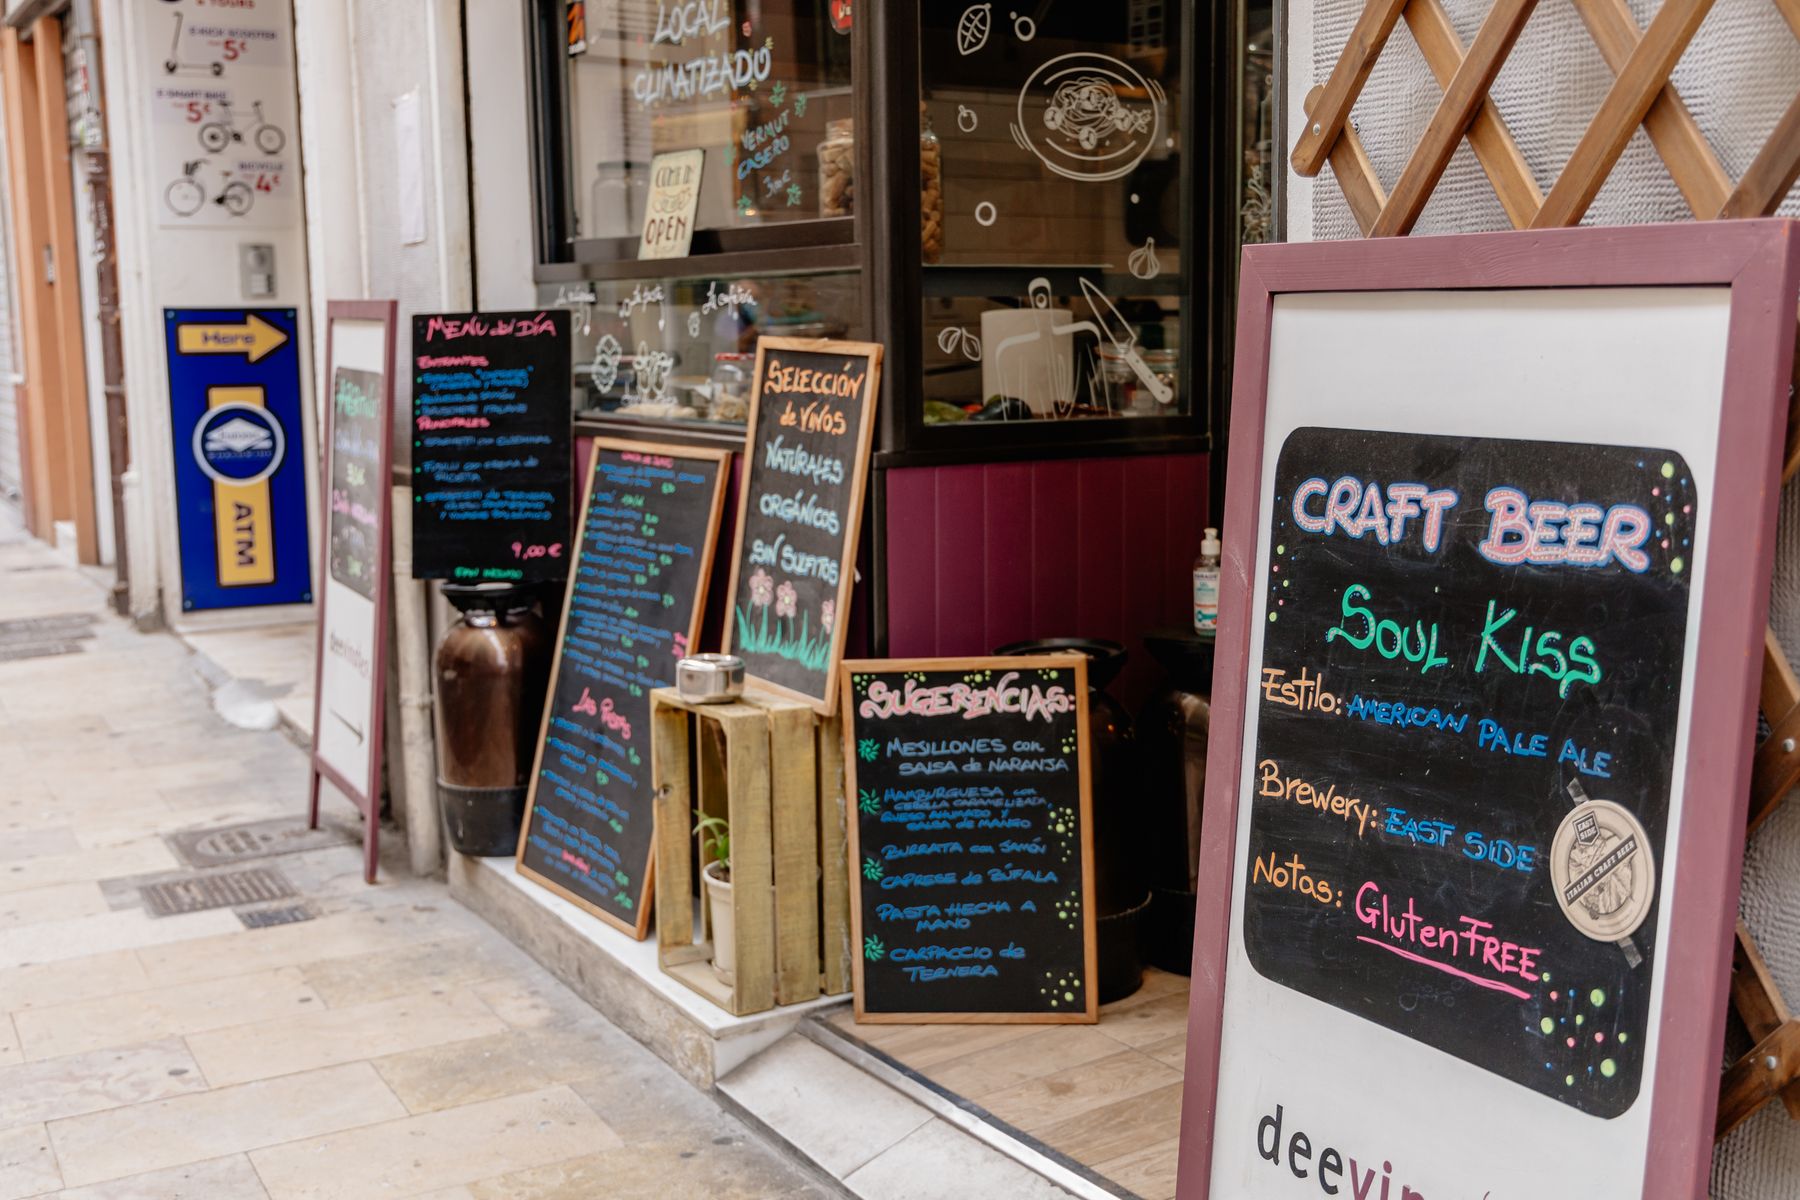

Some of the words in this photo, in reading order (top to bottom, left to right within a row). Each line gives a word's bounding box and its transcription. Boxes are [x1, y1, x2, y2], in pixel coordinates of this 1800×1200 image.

[652, 0, 731, 46] LOCAL
[632, 46, 772, 104] CLIMATIZADO
[741, 109, 790, 151] VERMUT
[645, 216, 689, 246] OPEN
[202, 331, 256, 345] Here
[763, 360, 865, 400] SELECCIÓN
[780, 401, 797, 426] de
[765, 434, 844, 485] NATURALES
[234, 502, 256, 566] ATM
[1292, 476, 1458, 552] CRAFT
[1479, 486, 1652, 572] BEER
[750, 533, 785, 567] SIN
[780, 543, 839, 586] SULFITOS
[1260, 667, 1343, 715] Estilo:
[1346, 694, 1468, 733] AMERICAN
[1478, 718, 1547, 758] PALE
[1558, 738, 1613, 778] ALE
[1013, 740, 1046, 753] con
[899, 761, 959, 776] SALSA
[962, 757, 982, 772] de
[988, 757, 1069, 773] NARANJA
[884, 786, 1005, 802] HAMBURGUESA
[1258, 759, 1378, 837] Brewery:
[1384, 807, 1456, 848] EAST
[1462, 832, 1536, 873] SIDE
[1577, 816, 1595, 832] EAST
[1580, 827, 1597, 841] SIDE
[881, 840, 964, 860] BURRATA
[880, 871, 958, 890] CAPRESE
[961, 871, 984, 885] de
[1252, 852, 1343, 907] Notas:
[1566, 874, 1595, 901] ITALIAN
[1593, 856, 1617, 879] CRAFT
[1617, 841, 1636, 860] BEER
[876, 903, 942, 922] PASTA
[944, 900, 1012, 916] HECHA
[1019, 900, 1037, 913] A
[915, 917, 971, 933] MANO
[889, 945, 993, 962] CARPACCIO
[999, 941, 1026, 959] de
[902, 964, 999, 983] TERNERA
